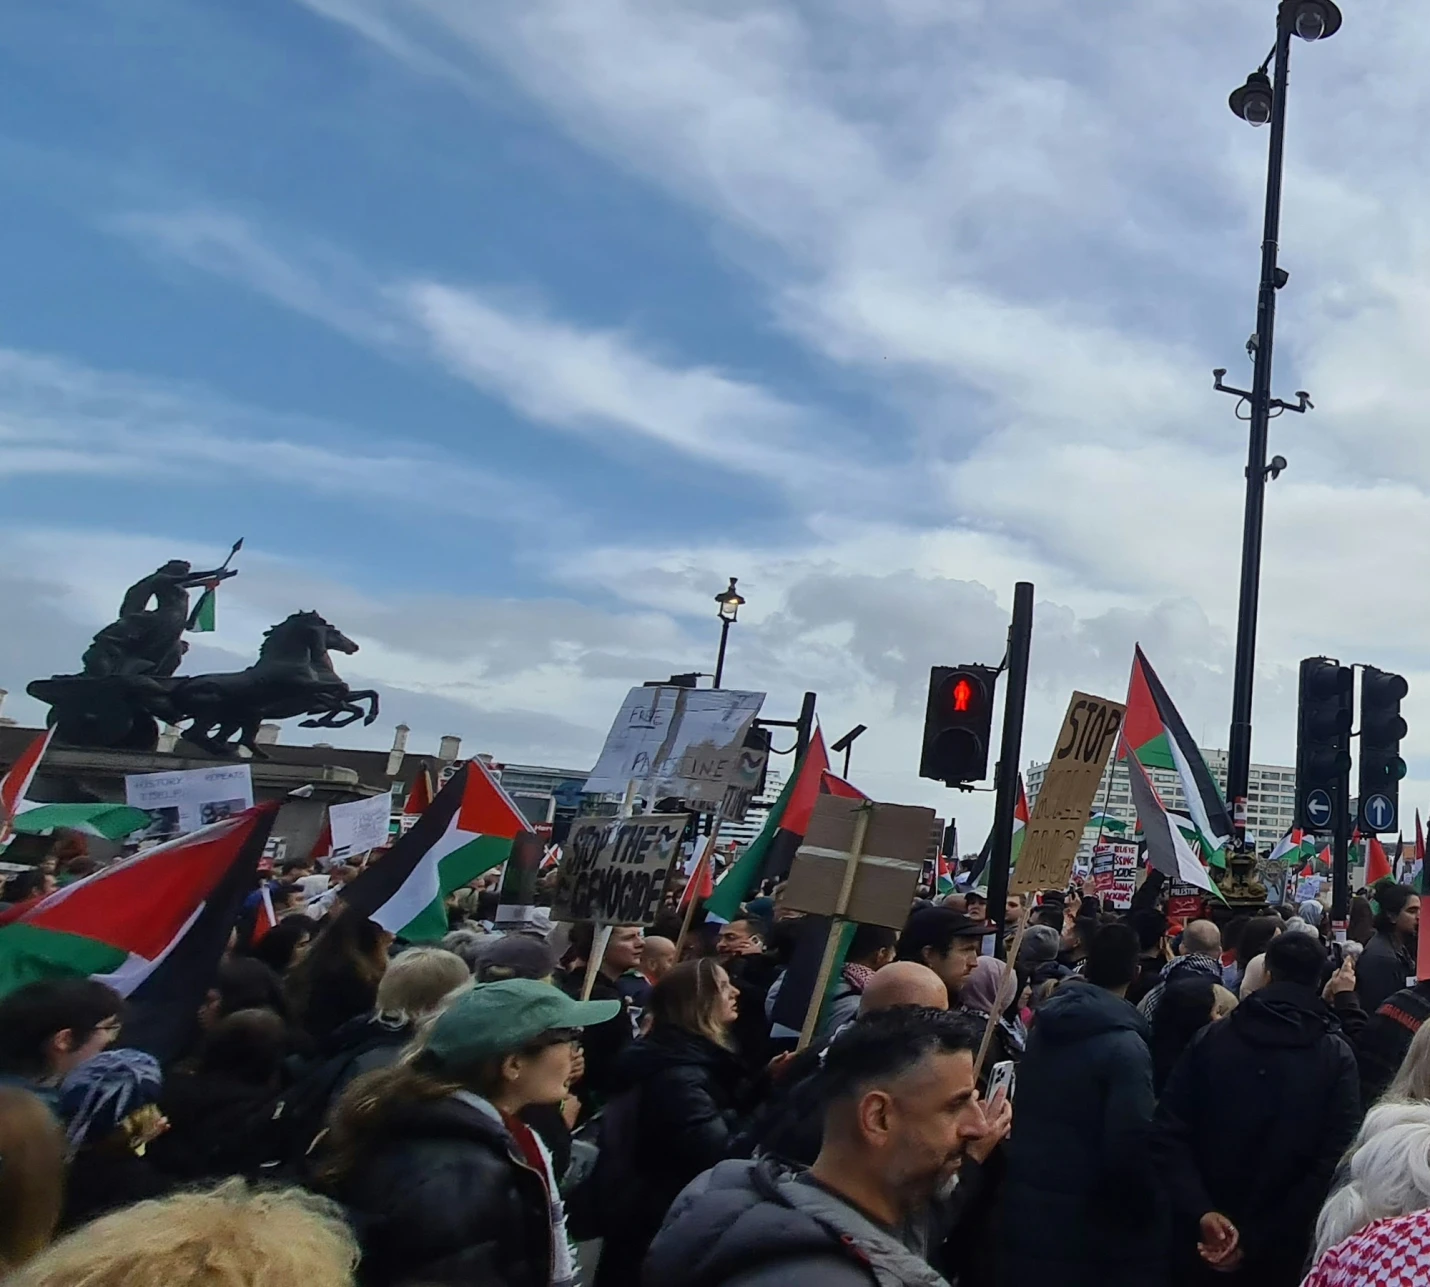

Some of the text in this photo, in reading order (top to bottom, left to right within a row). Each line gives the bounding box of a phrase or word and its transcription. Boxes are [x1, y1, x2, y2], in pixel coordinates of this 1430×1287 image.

[1057, 701, 1123, 764] STOP
[610, 824, 659, 864] THE
[1170, 887, 1200, 896] PALESTINE
